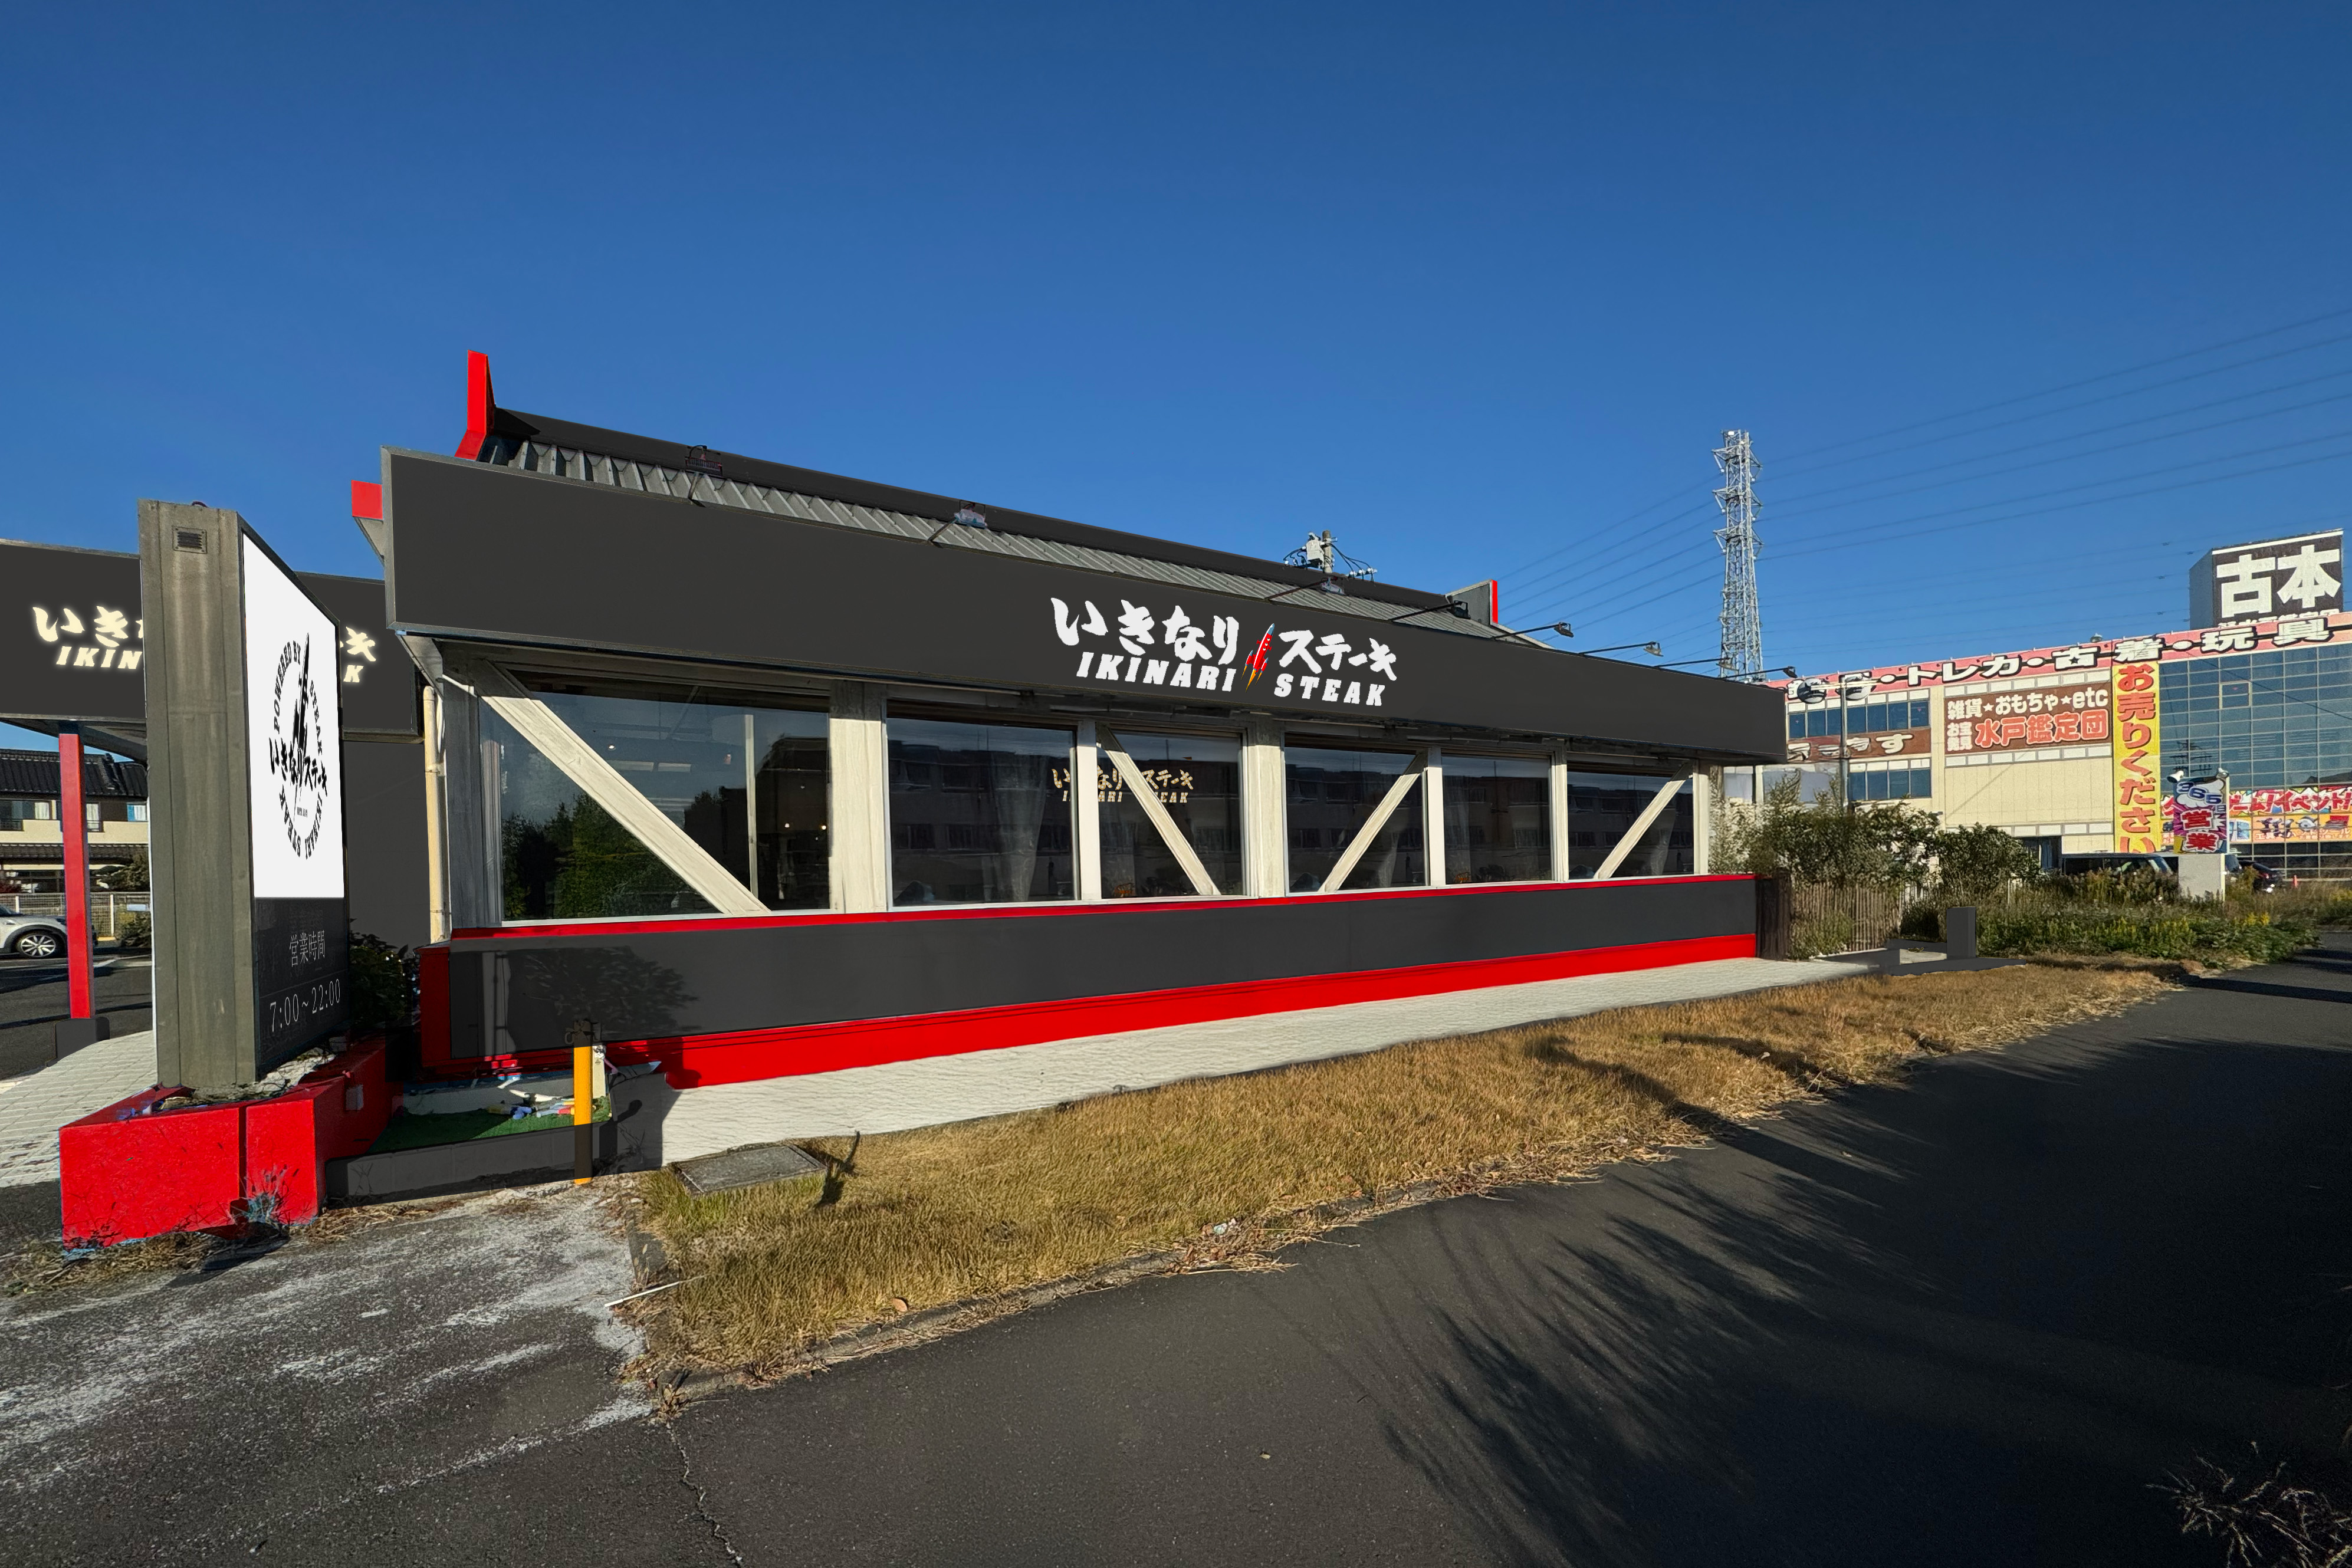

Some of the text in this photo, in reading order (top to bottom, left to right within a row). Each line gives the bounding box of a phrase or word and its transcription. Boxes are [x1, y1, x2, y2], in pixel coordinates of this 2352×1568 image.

[2216, 544, 2341, 618] 古本
[1050, 597, 1397, 681] いきなり ステーキ
[274, 640, 322, 756] POWERED BY STEAK
[1076, 652, 1385, 706] IKINARI STEAK
[2072, 687, 2108, 709] etc
[1975, 709, 2109, 748] 水戸鑑定団
[2117, 664, 2156, 853] お売りください
[1052, 765, 1122, 791] いなり
[279, 784, 323, 860] IKINARI STEAK
[290, 930, 324, 968] 営業時間
